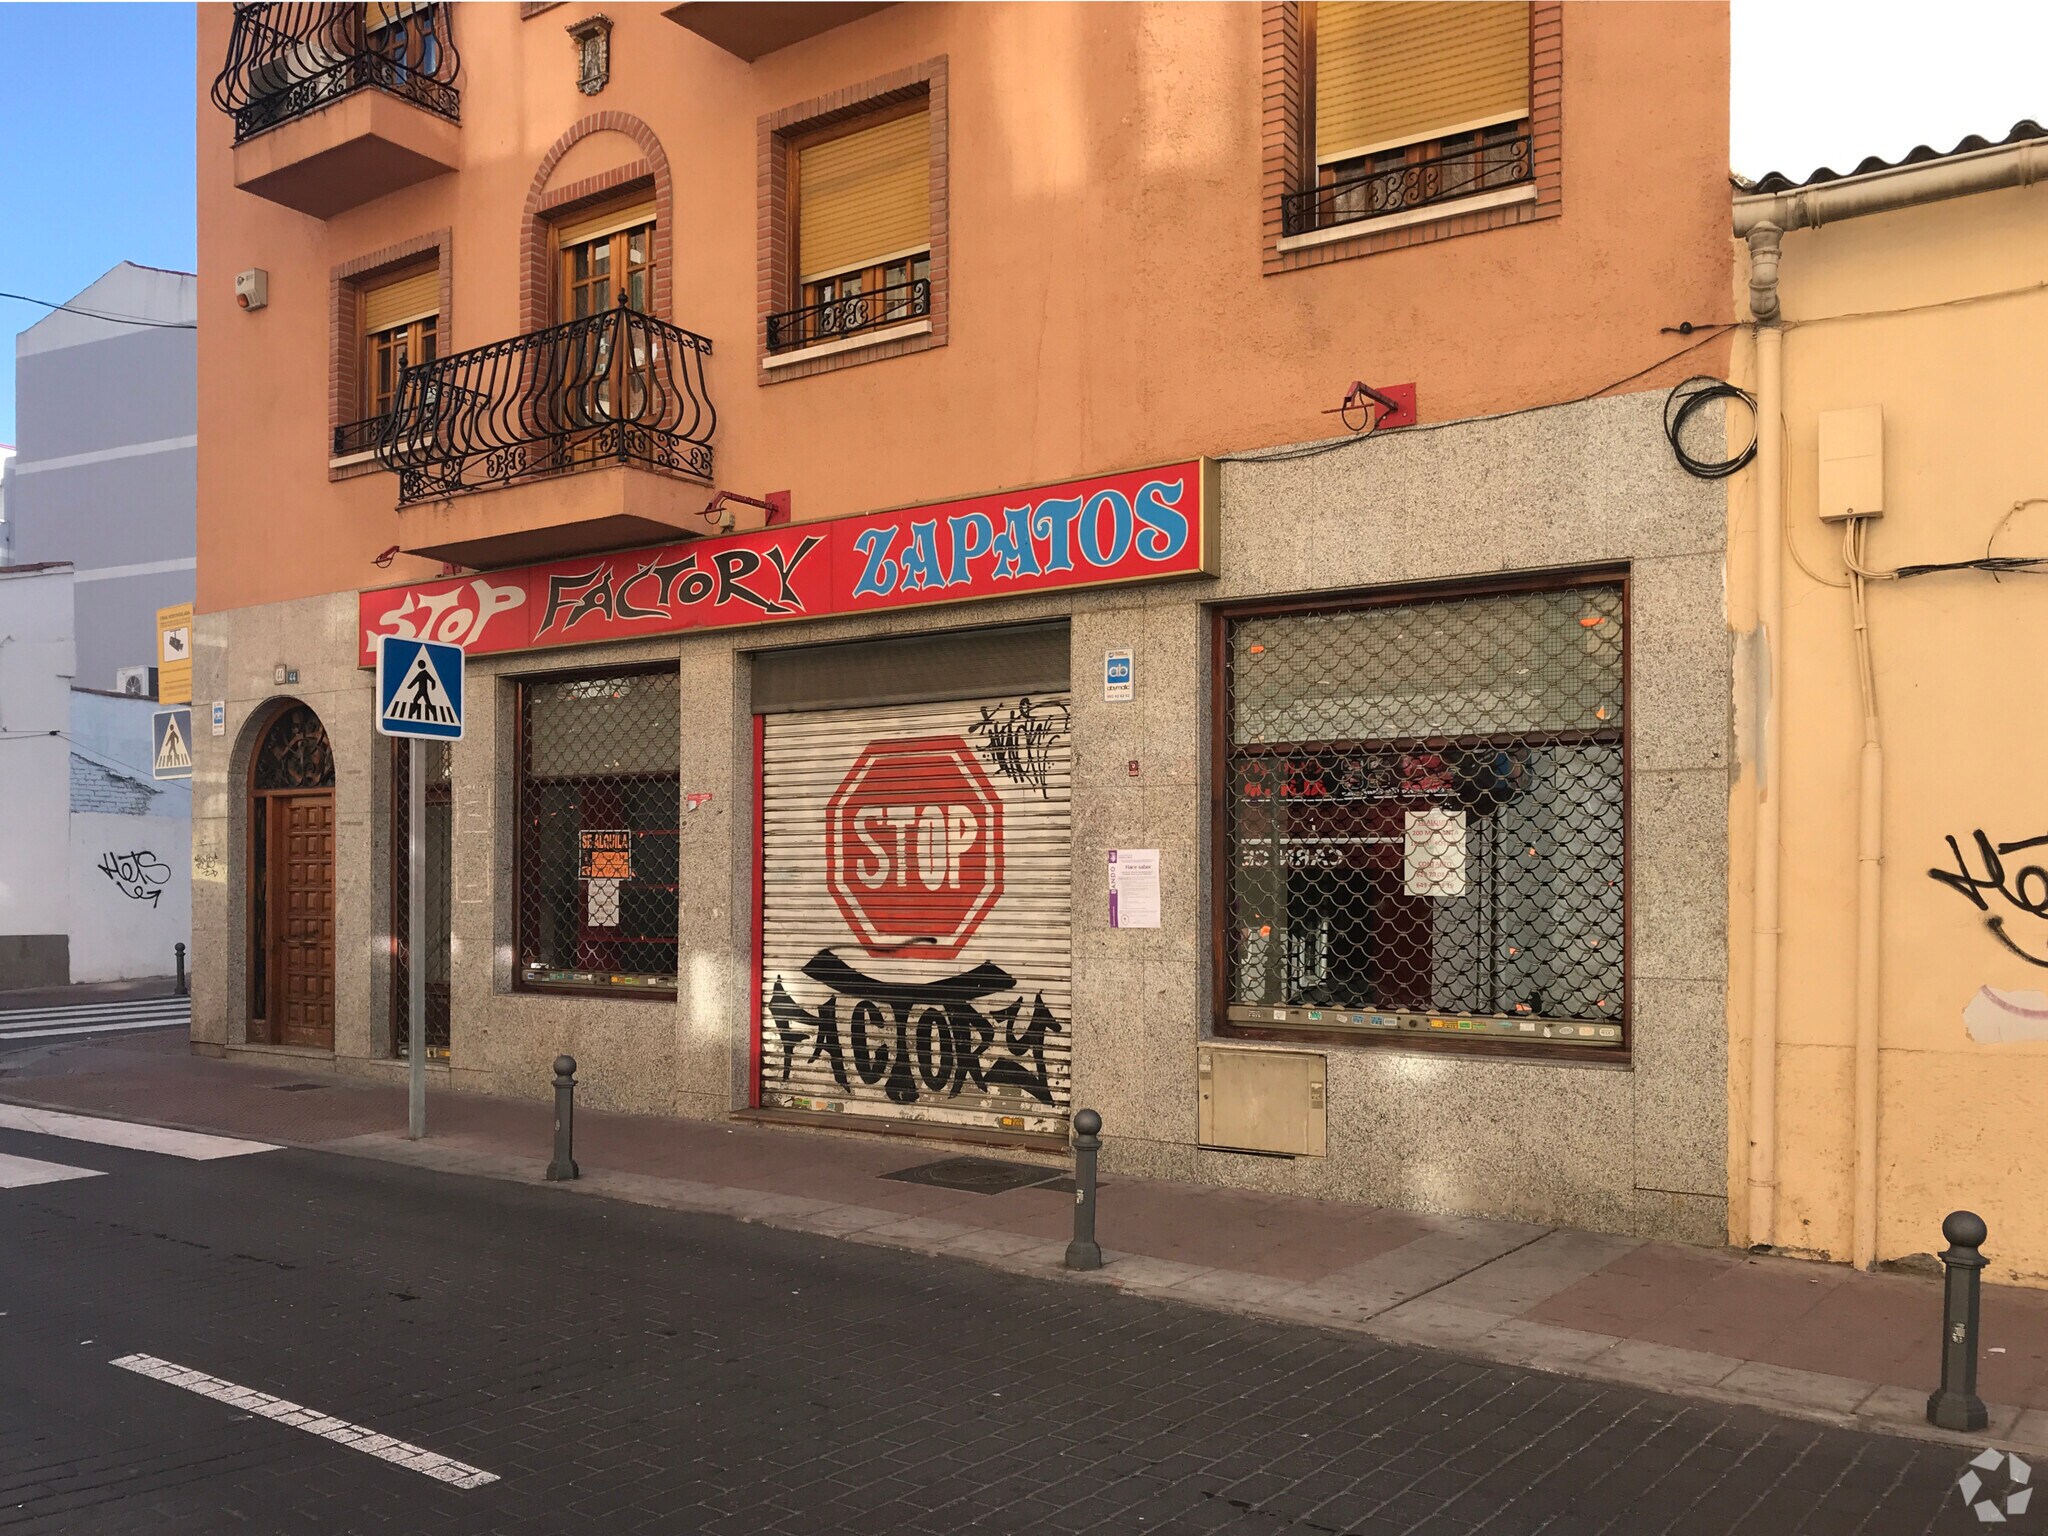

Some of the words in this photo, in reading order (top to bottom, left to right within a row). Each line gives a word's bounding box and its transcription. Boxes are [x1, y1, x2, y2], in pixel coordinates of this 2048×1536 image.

[365, 579, 526, 654] STOP
[533, 534, 828, 643] FACTORY
[852, 478, 1189, 599] ZAPATOS
[1109, 663, 1128, 678] ab
[582, 834, 592, 849] SE
[594, 834, 628, 849] ALQUILA
[854, 804, 978, 891] STOP
[769, 950, 1062, 1107] FACTORY
